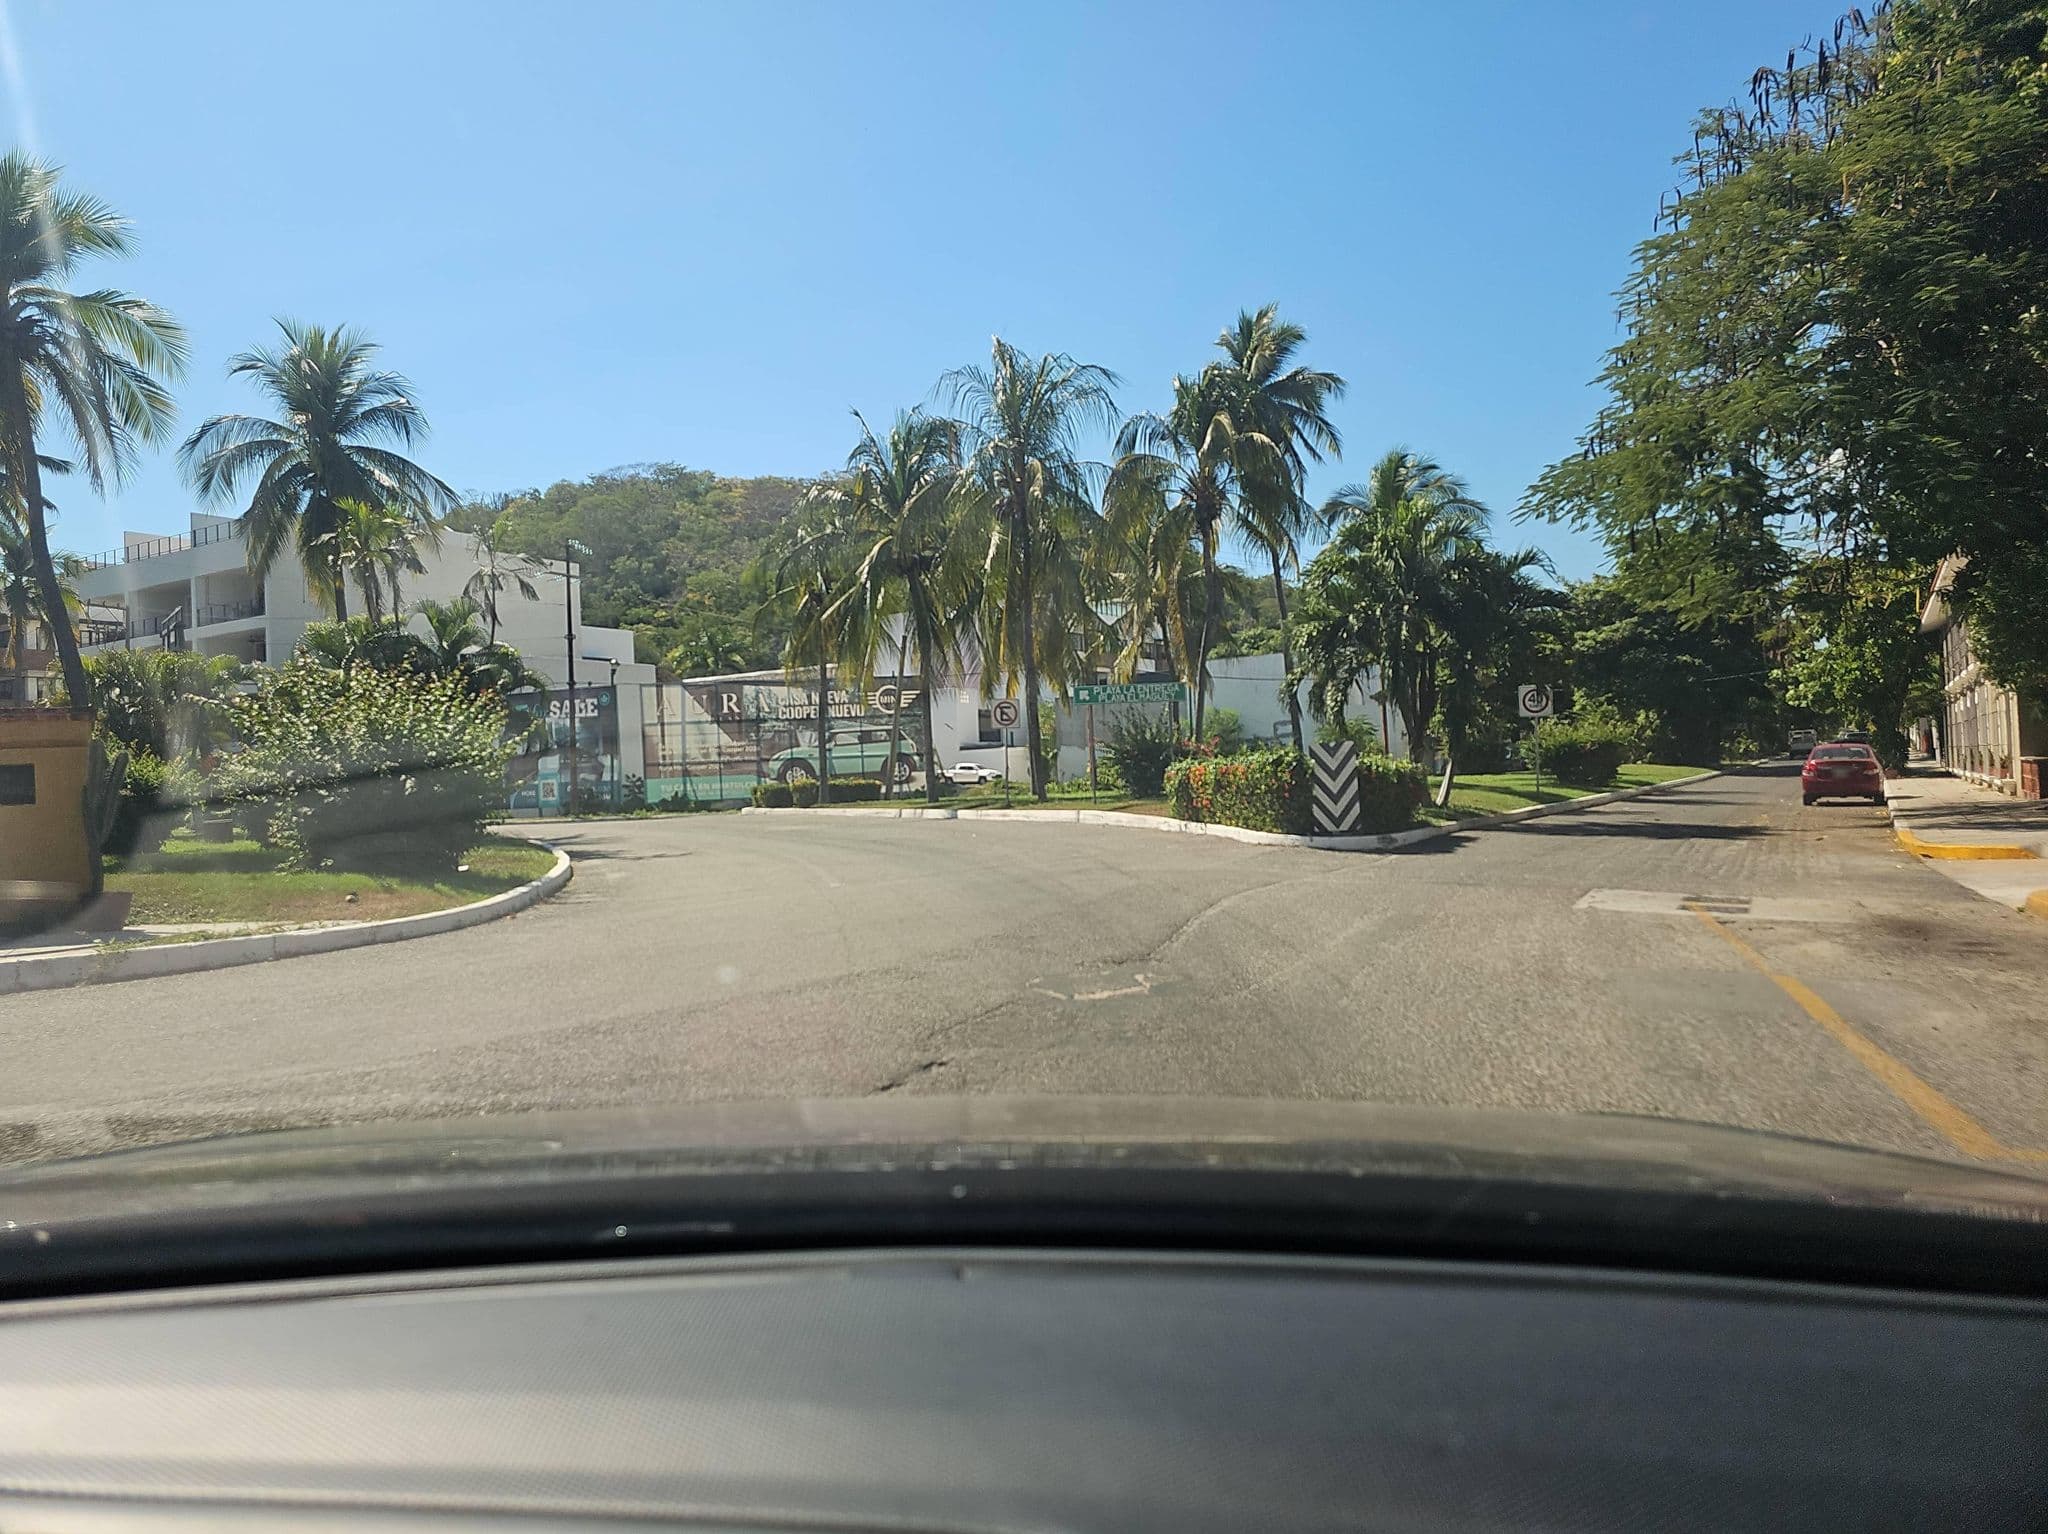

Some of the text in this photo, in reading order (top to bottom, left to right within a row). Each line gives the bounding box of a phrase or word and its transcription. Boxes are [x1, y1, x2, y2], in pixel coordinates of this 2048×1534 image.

[811, 690, 849, 705] NEVA
[1094, 686, 1122, 695] PLAYA
[549, 698, 598, 718] SALE
[779, 705, 822, 719] COOPE
